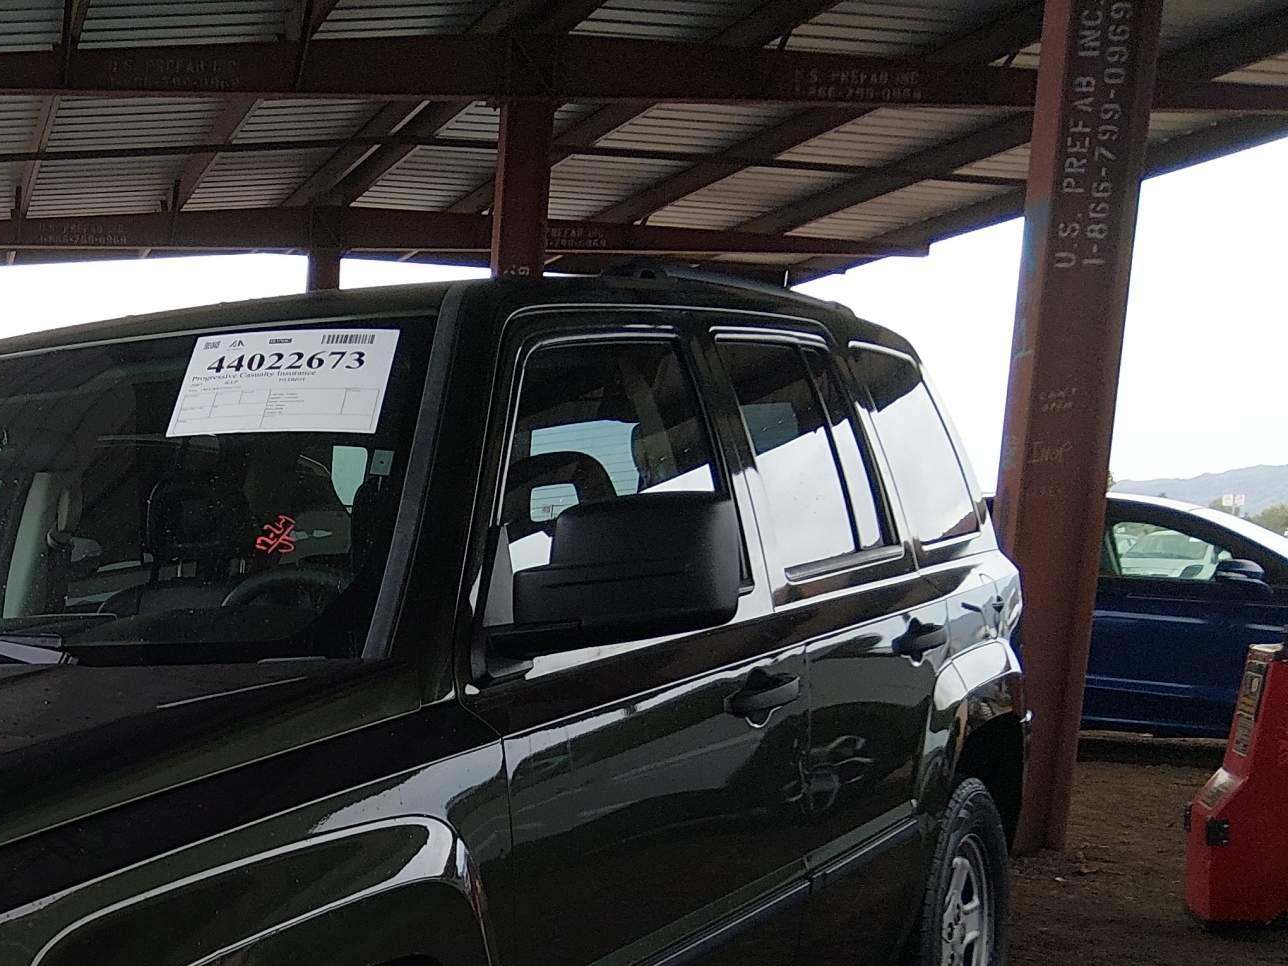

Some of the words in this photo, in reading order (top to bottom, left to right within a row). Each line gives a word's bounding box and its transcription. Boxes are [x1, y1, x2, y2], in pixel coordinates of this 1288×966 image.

[1063, 75, 1096, 193] PREFAB
[1082, 2, 1133, 265] 1-866-799-0969
[206, 351, 366, 374] 44022673
